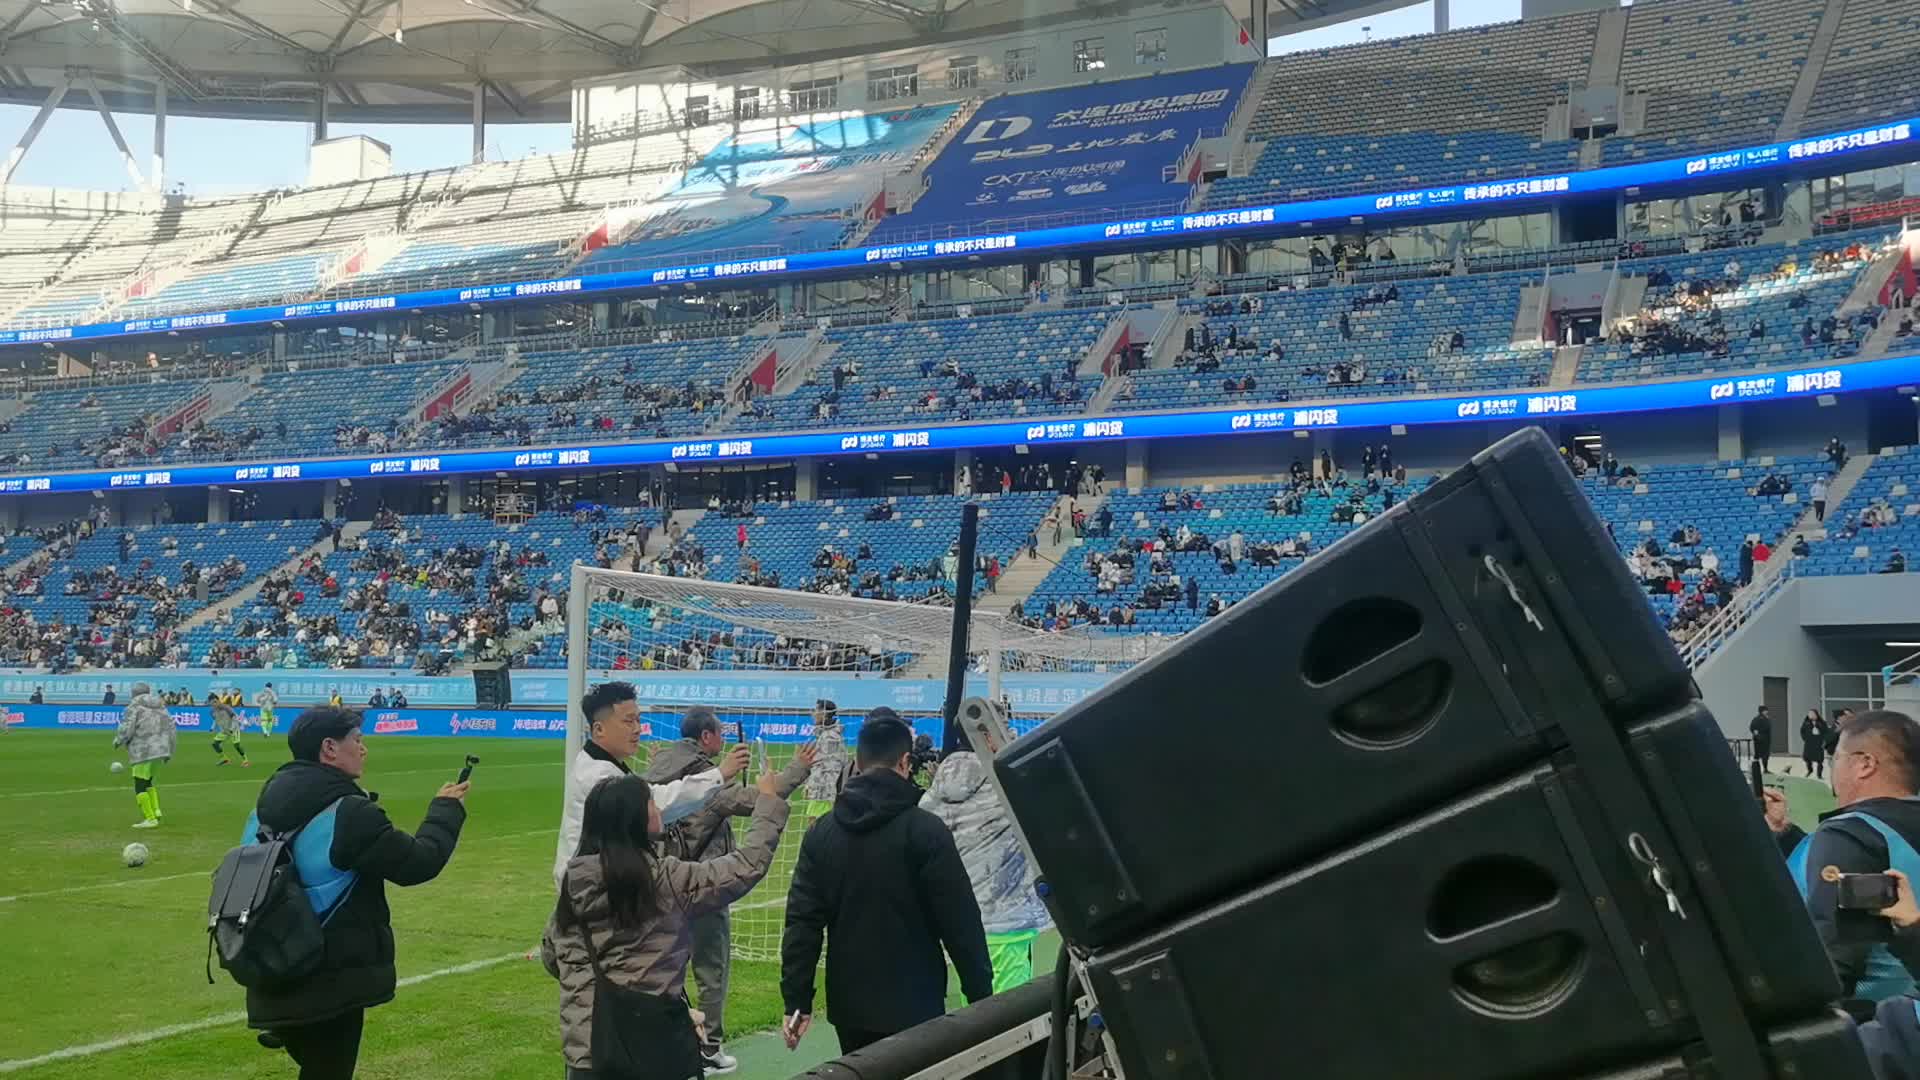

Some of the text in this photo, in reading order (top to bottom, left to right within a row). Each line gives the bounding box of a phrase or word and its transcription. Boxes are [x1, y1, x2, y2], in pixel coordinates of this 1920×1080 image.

[1053, 89, 1229, 122] 大连城投集团
[1788, 124, 1909, 158] 传承的不只是财富
[1464, 177, 1569, 200] 传承的不只是财富
[1183, 208, 1274, 230] 传承的不只是财富
[934, 235, 1016, 254] 传承的不只是财富
[714, 258, 786, 276] 传承的不只是财富
[516, 279, 581, 295] 传承的不只是财富
[1786, 370, 1841, 392] 浦闪贷
[1527, 395, 1576, 413] 浦闪贷
[1294, 409, 1337, 425] 浦闪贷
[1083, 421, 1123, 436] 浦闪贷
[893, 432, 929, 447] 浦闪贷
[558, 450, 590, 464] 浦闪贷
[718, 441, 752, 456] 浦闪贷
[272, 465, 300, 478] 浦闪贷
[410, 458, 440, 472] 浦闪贷
